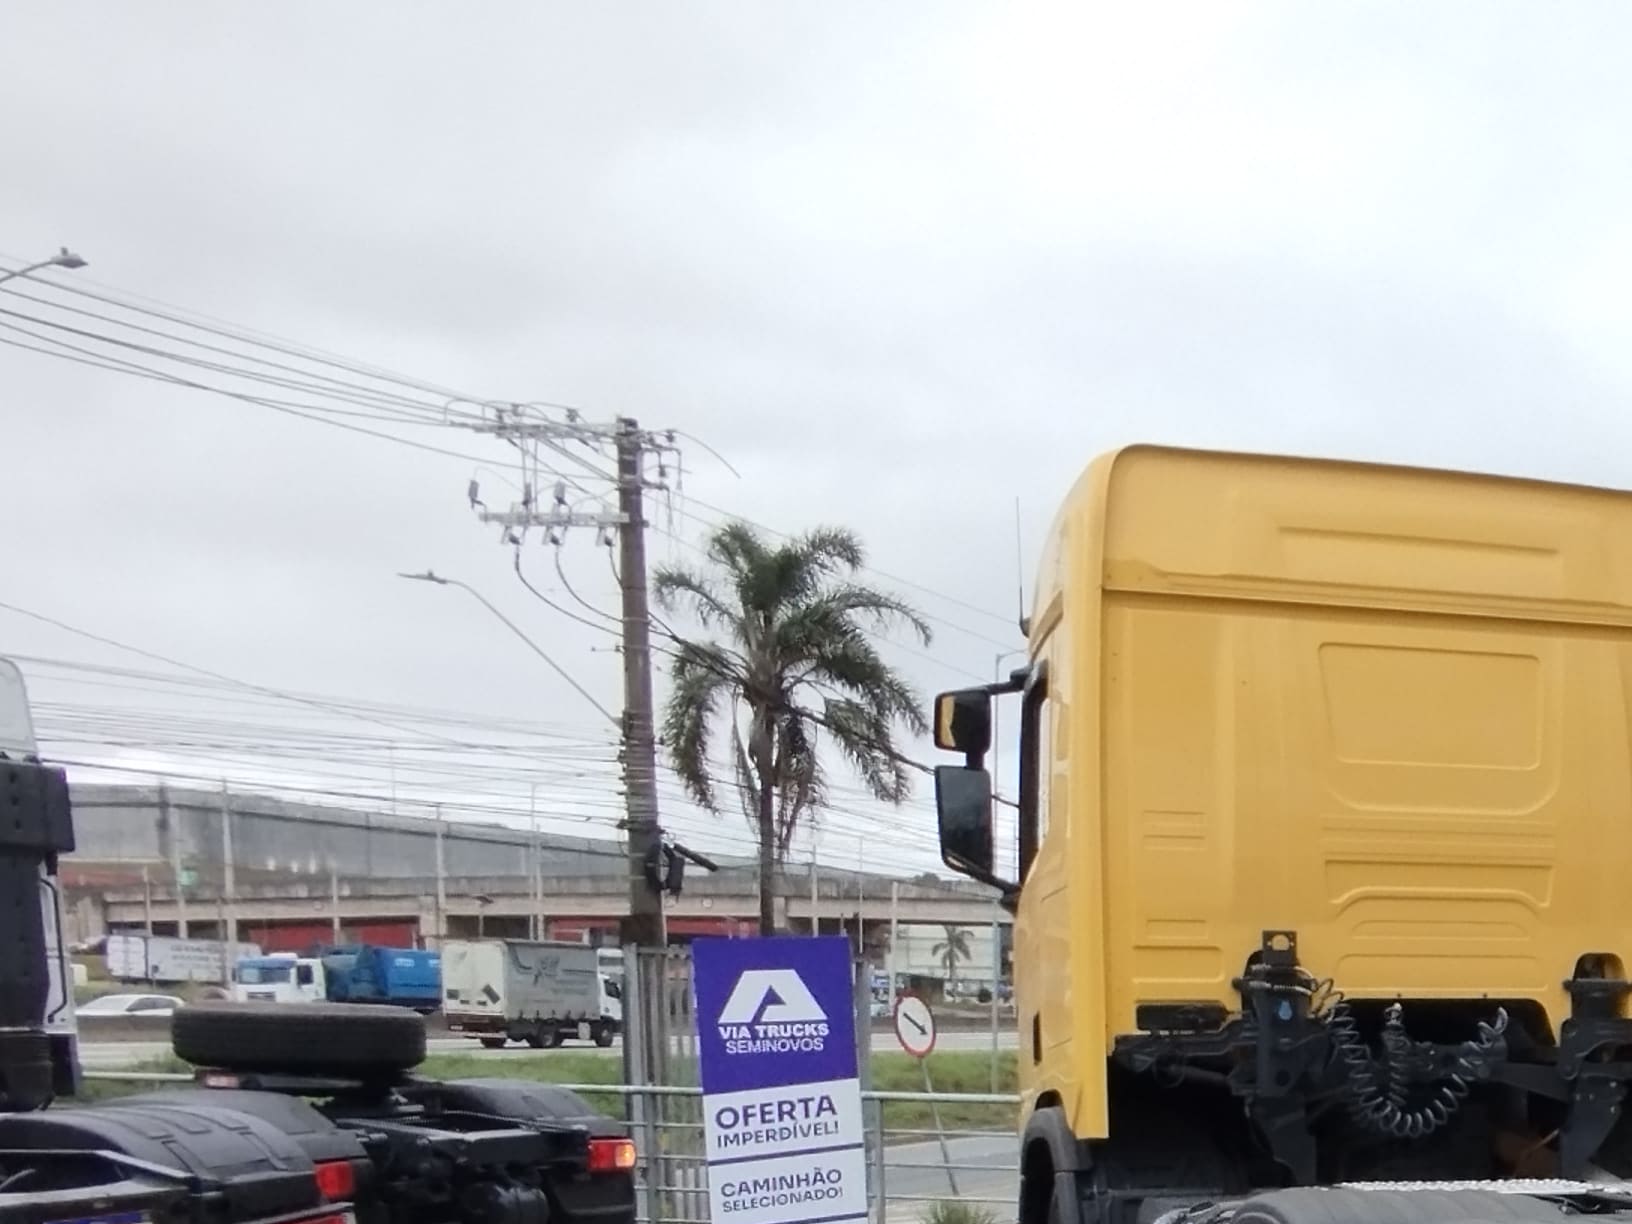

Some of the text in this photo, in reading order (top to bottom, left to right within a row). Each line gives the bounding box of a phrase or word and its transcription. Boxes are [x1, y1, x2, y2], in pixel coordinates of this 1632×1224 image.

[718, 1023, 829, 1040] VIA TRUCKS
[726, 1037, 824, 1054] SEMINOVOS
[715, 1095, 838, 1129] OFERTA
[717, 1120, 839, 1148] IMPERDÍVEL!
[720, 1166, 842, 1198] CAMINHÃO
[722, 1186, 844, 1213] SELECIONADO!
